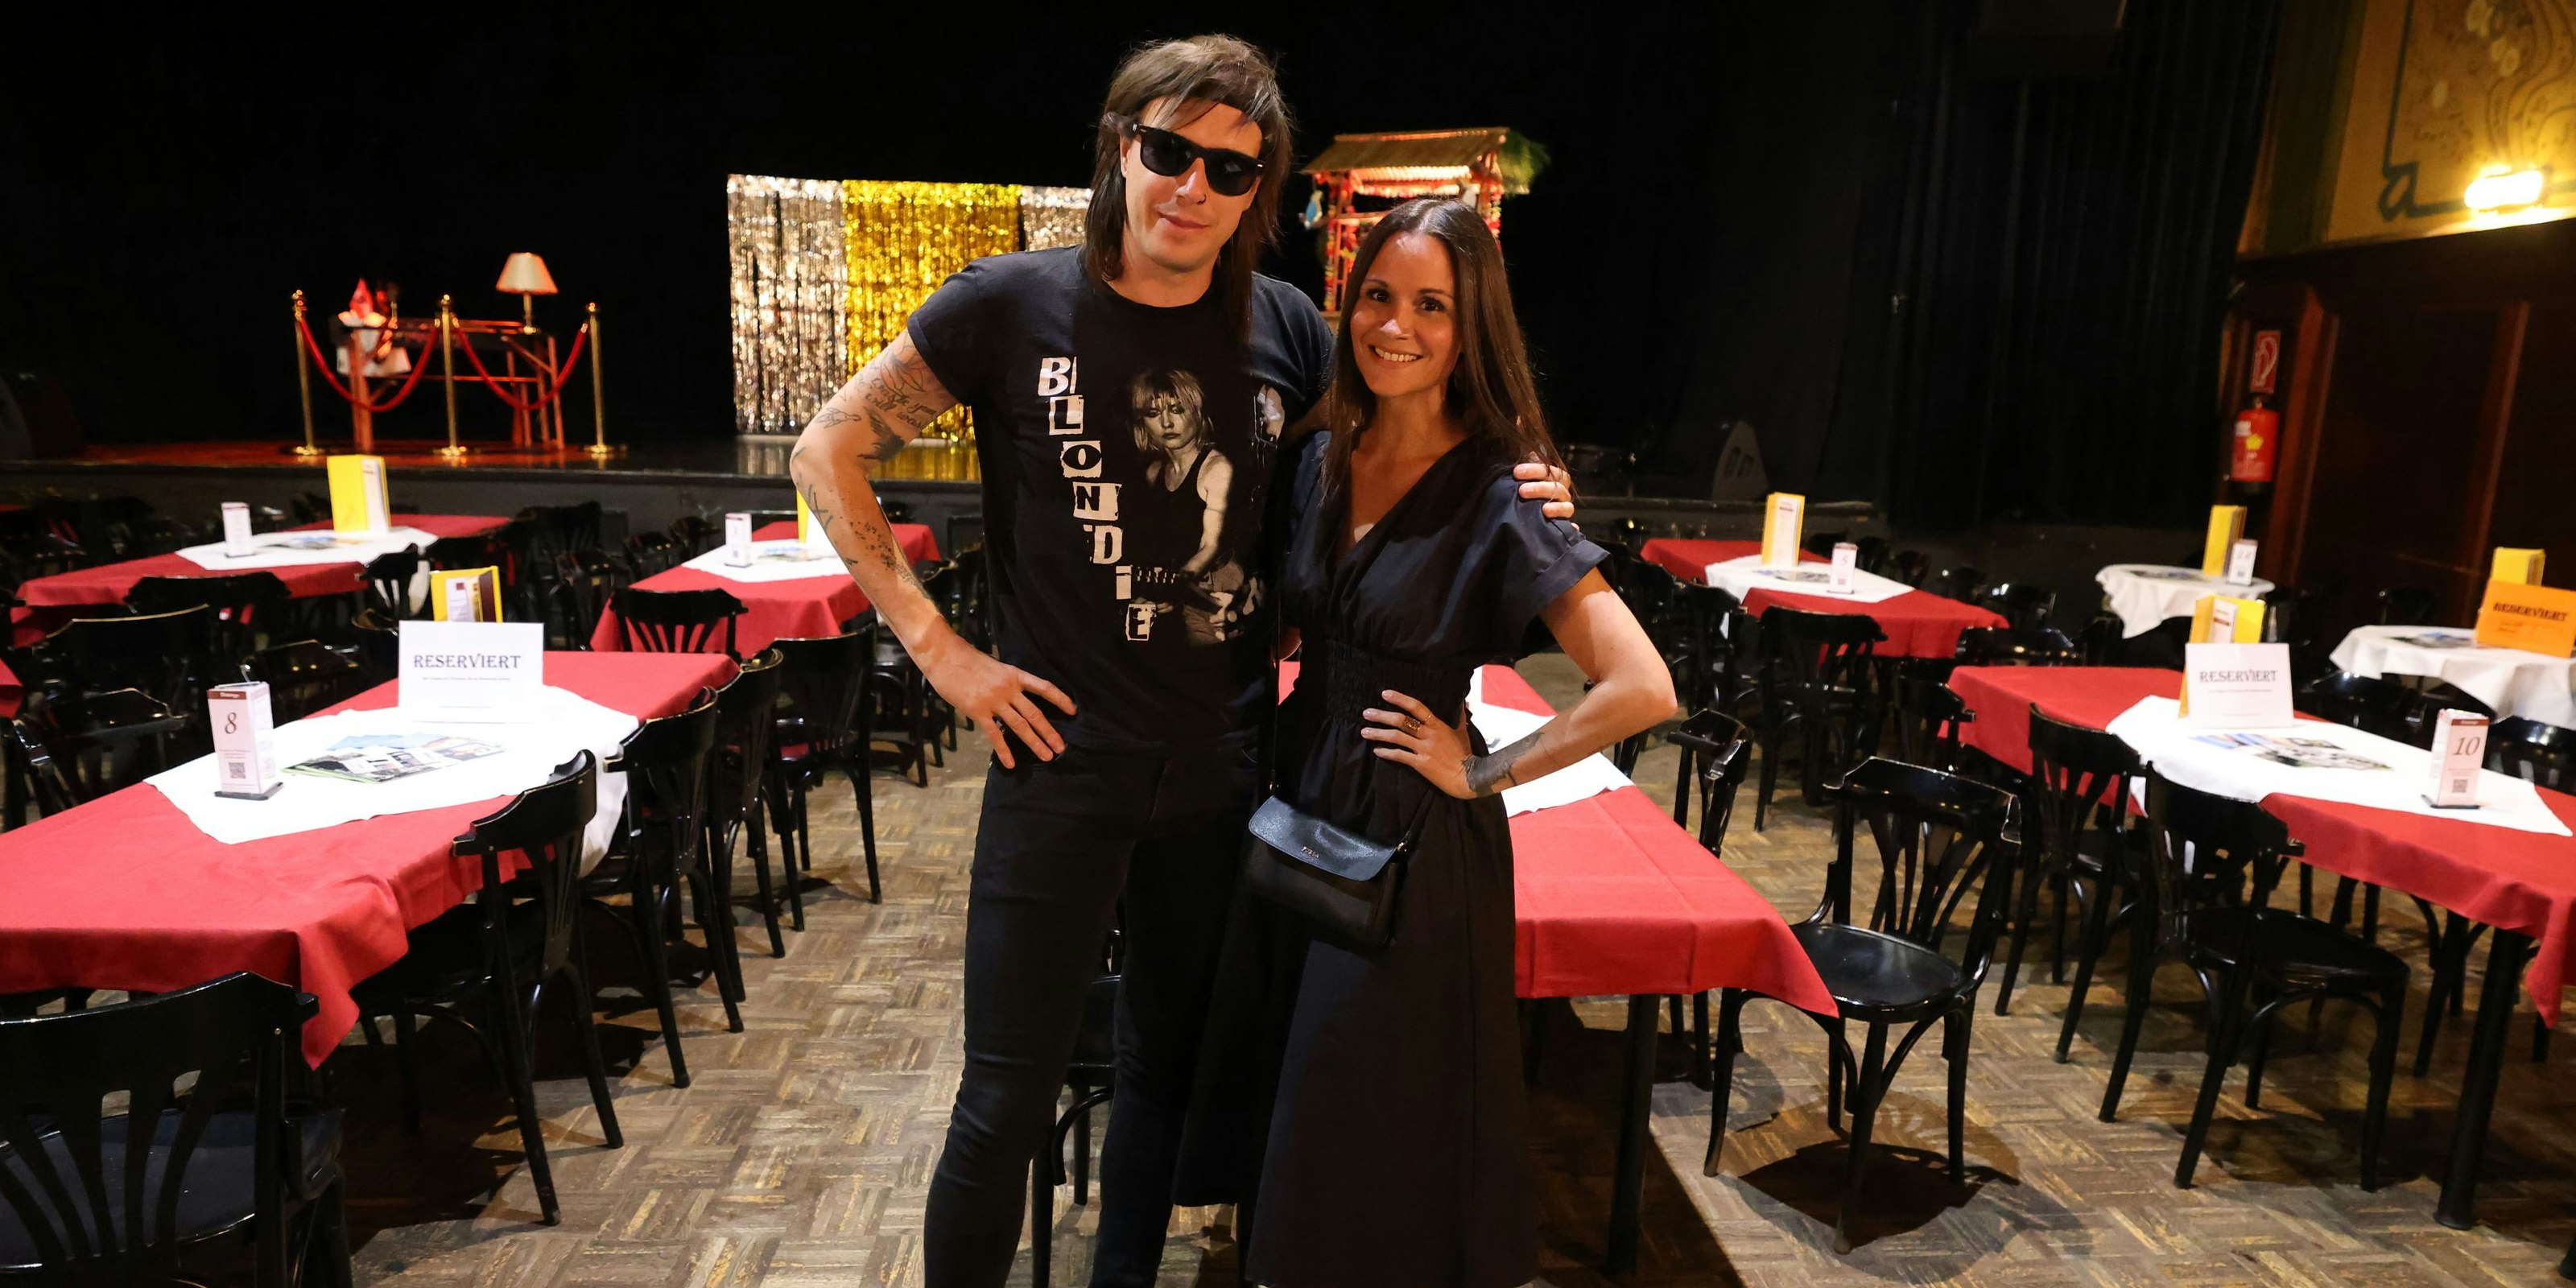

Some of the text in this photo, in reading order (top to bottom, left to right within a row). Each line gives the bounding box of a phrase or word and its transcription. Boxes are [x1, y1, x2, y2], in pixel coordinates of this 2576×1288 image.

[2493, 602, 2568, 621] RESERVIERT
[413, 653, 522, 669] RESERVIERT
[2199, 669, 2277, 683] RESERVIERT
[225, 712, 237, 735] 8
[2453, 737, 2481, 756] 10
